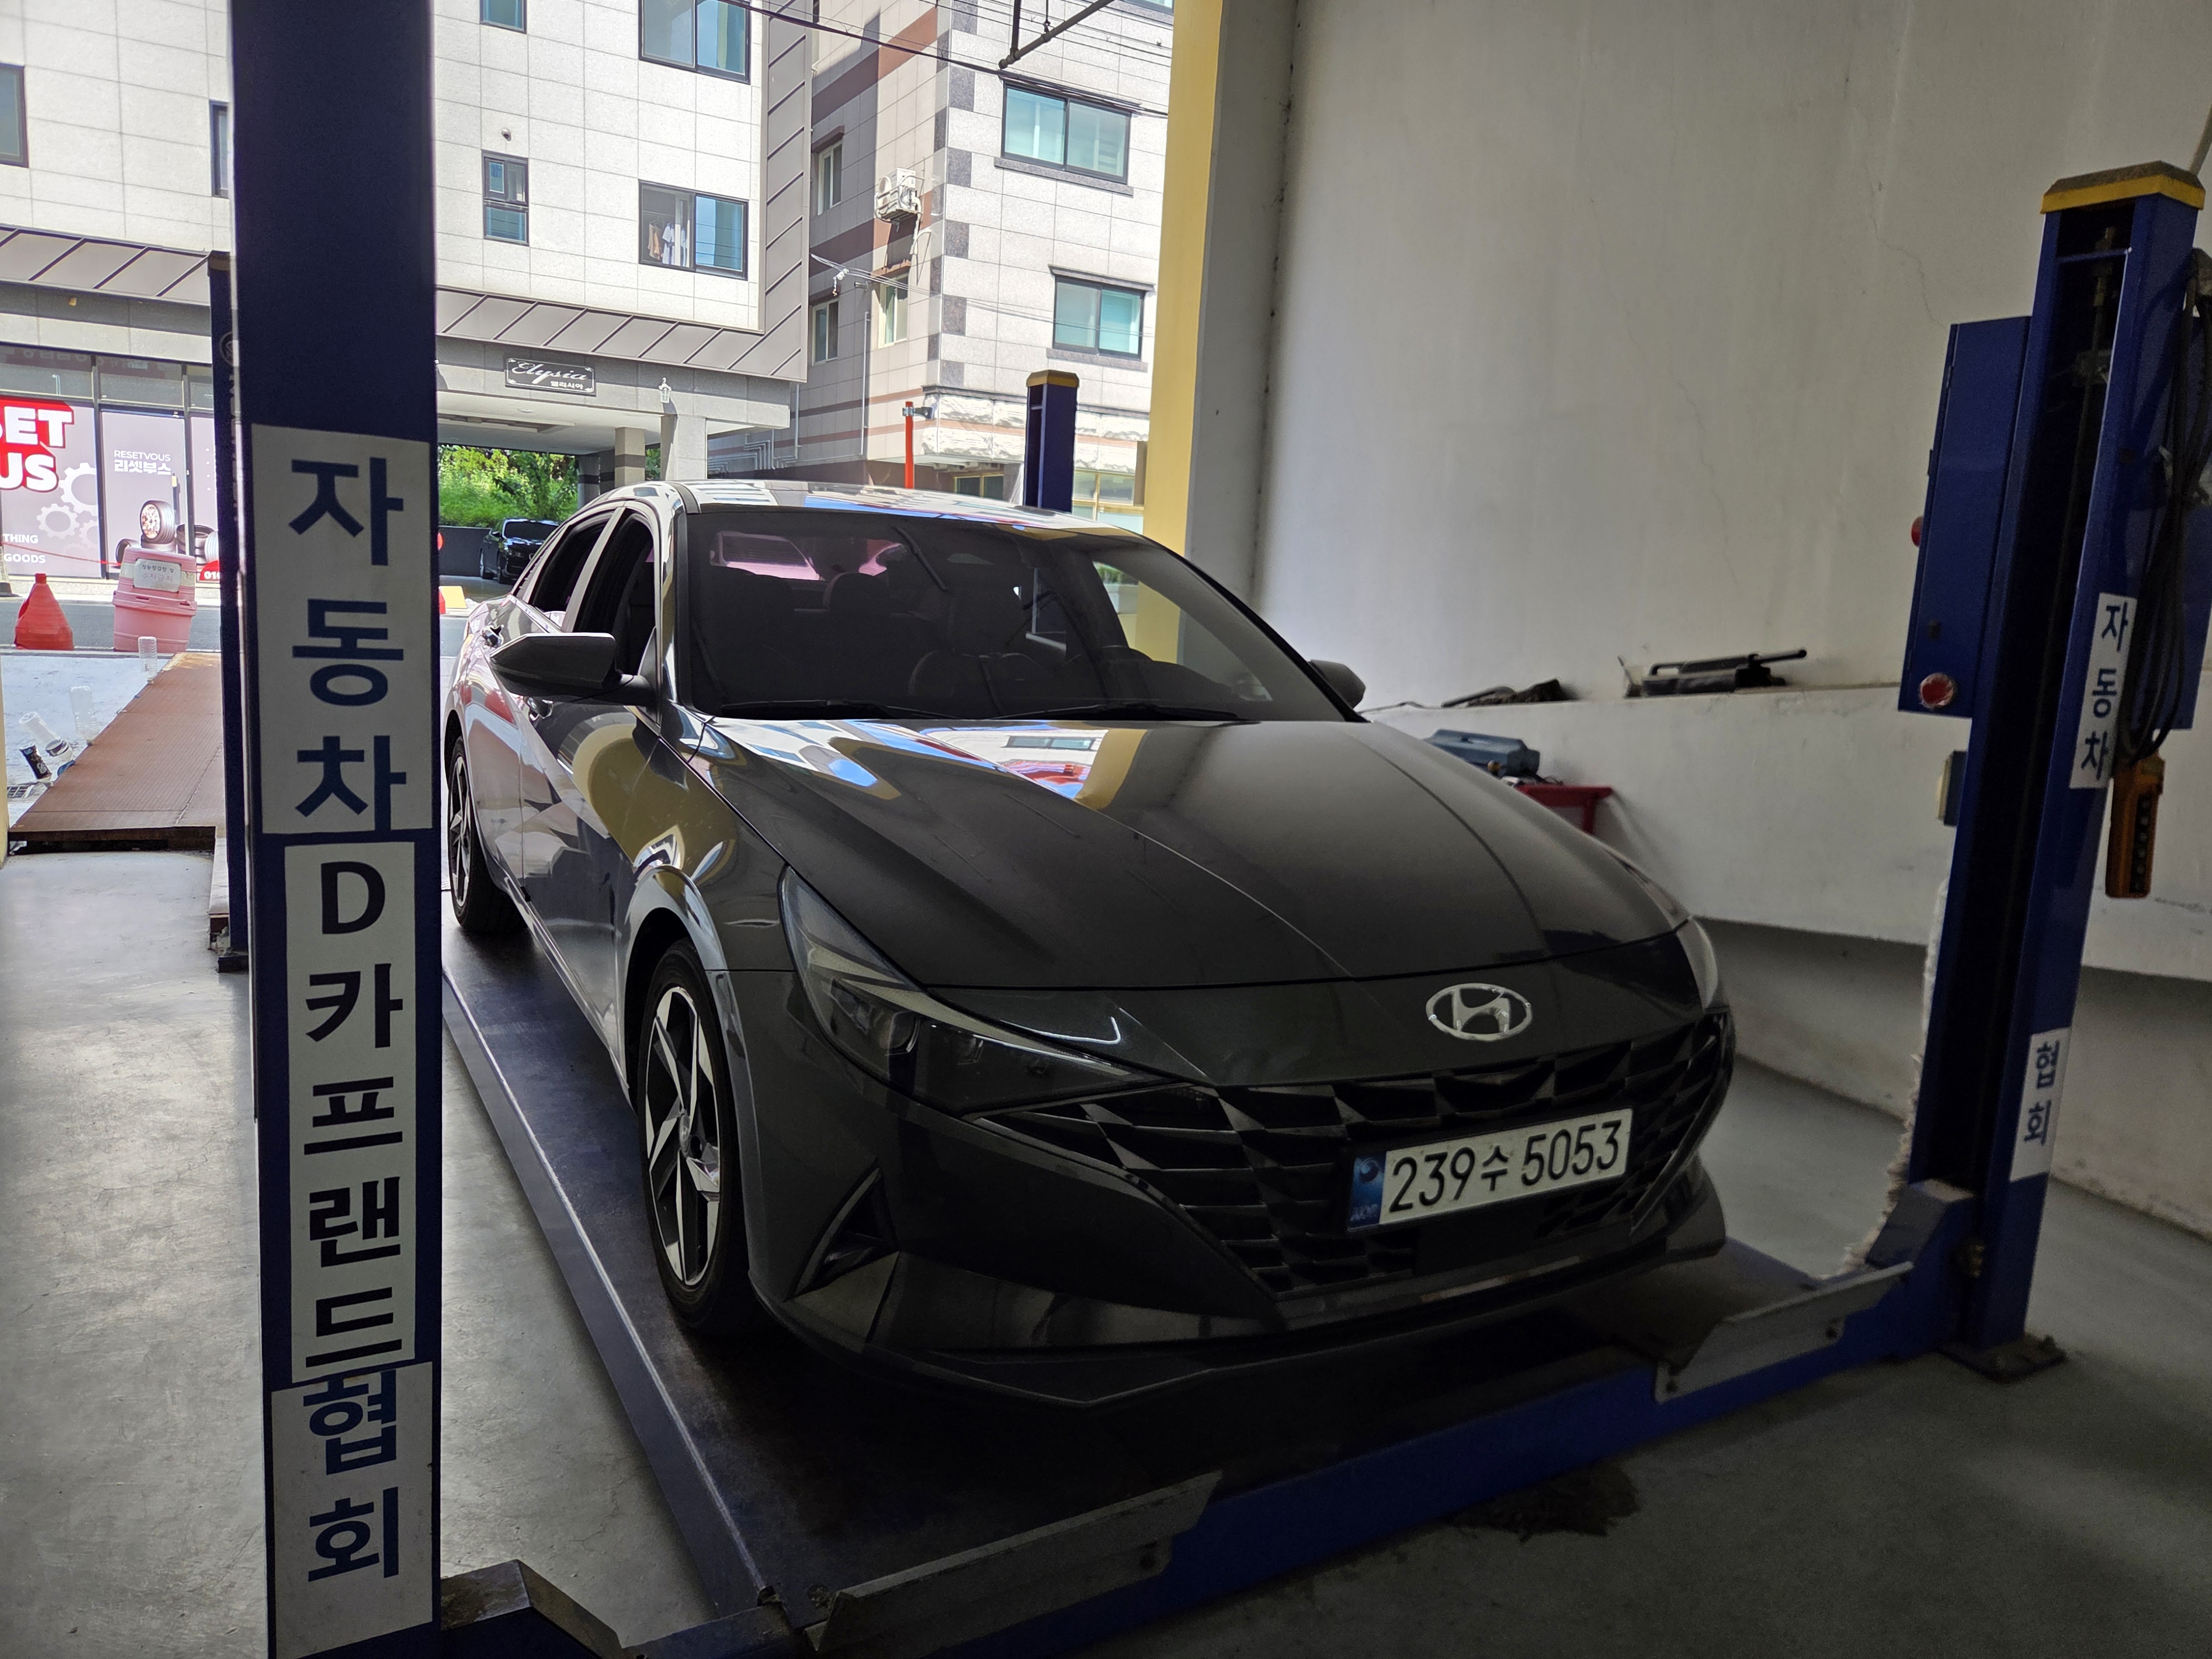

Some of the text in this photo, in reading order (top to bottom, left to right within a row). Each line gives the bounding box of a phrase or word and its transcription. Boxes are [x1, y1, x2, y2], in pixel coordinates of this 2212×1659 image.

[512, 361, 588, 384] Elysia
[0, 406, 72, 447] ET
[114, 450, 171, 462] RESETVOUS
[114, 459, 171, 475] 리셋부스
[3, 534, 39, 544] THING
[3, 553, 46, 564] GOODS
[289, 457, 406, 830] 자동차
[2081, 601, 2128, 780] 자동차
[2024, 1040, 2060, 1146] 협회
[304, 861, 403, 1368] D카프랜드
[303, 1369, 399, 1582] 협회
